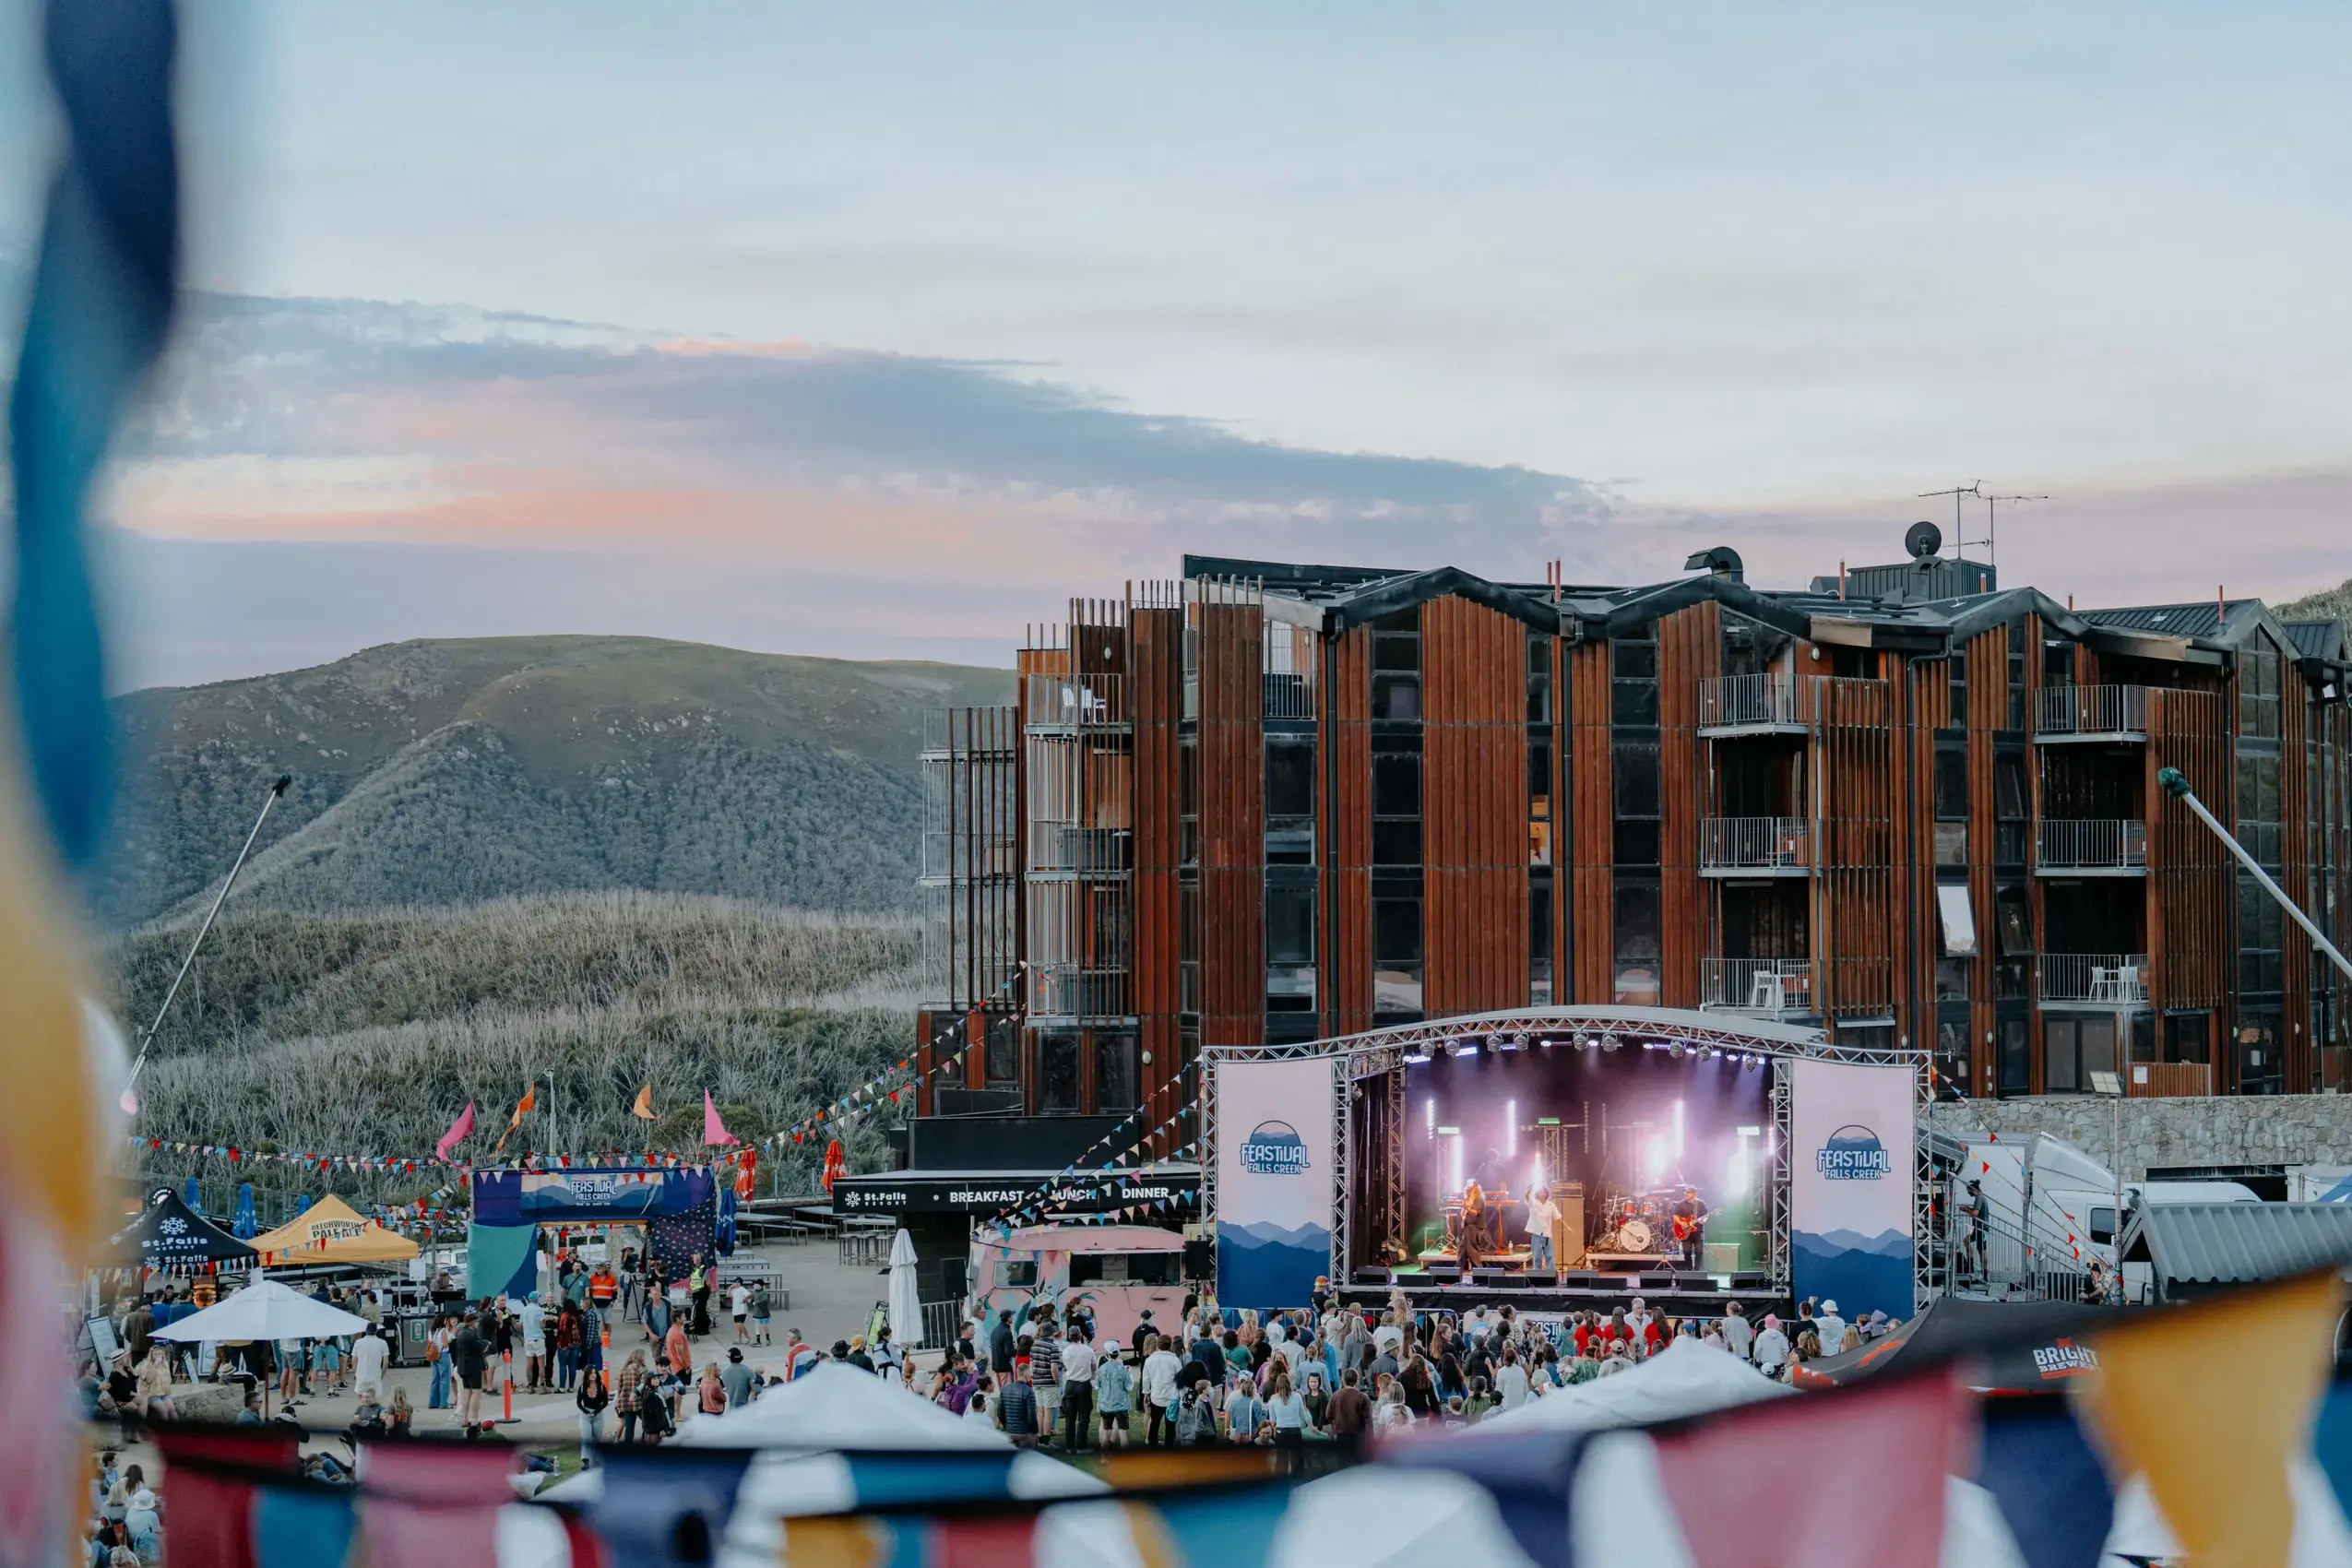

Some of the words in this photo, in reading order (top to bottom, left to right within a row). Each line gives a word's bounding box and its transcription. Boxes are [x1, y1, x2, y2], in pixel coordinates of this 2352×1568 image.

[1248, 1163, 1272, 1173] FALLS
[1273, 1163, 1301, 1174] CREEK
[1825, 1169, 1850, 1179] FALLS
[1852, 1169, 1881, 1180] CREEK
[949, 1190, 1025, 1203] BREAKFAST
[1122, 1187, 1170, 1199] DINNER
[2033, 1345, 2099, 1366] BRIGHT
[2038, 1360, 2100, 1372] BREWER
